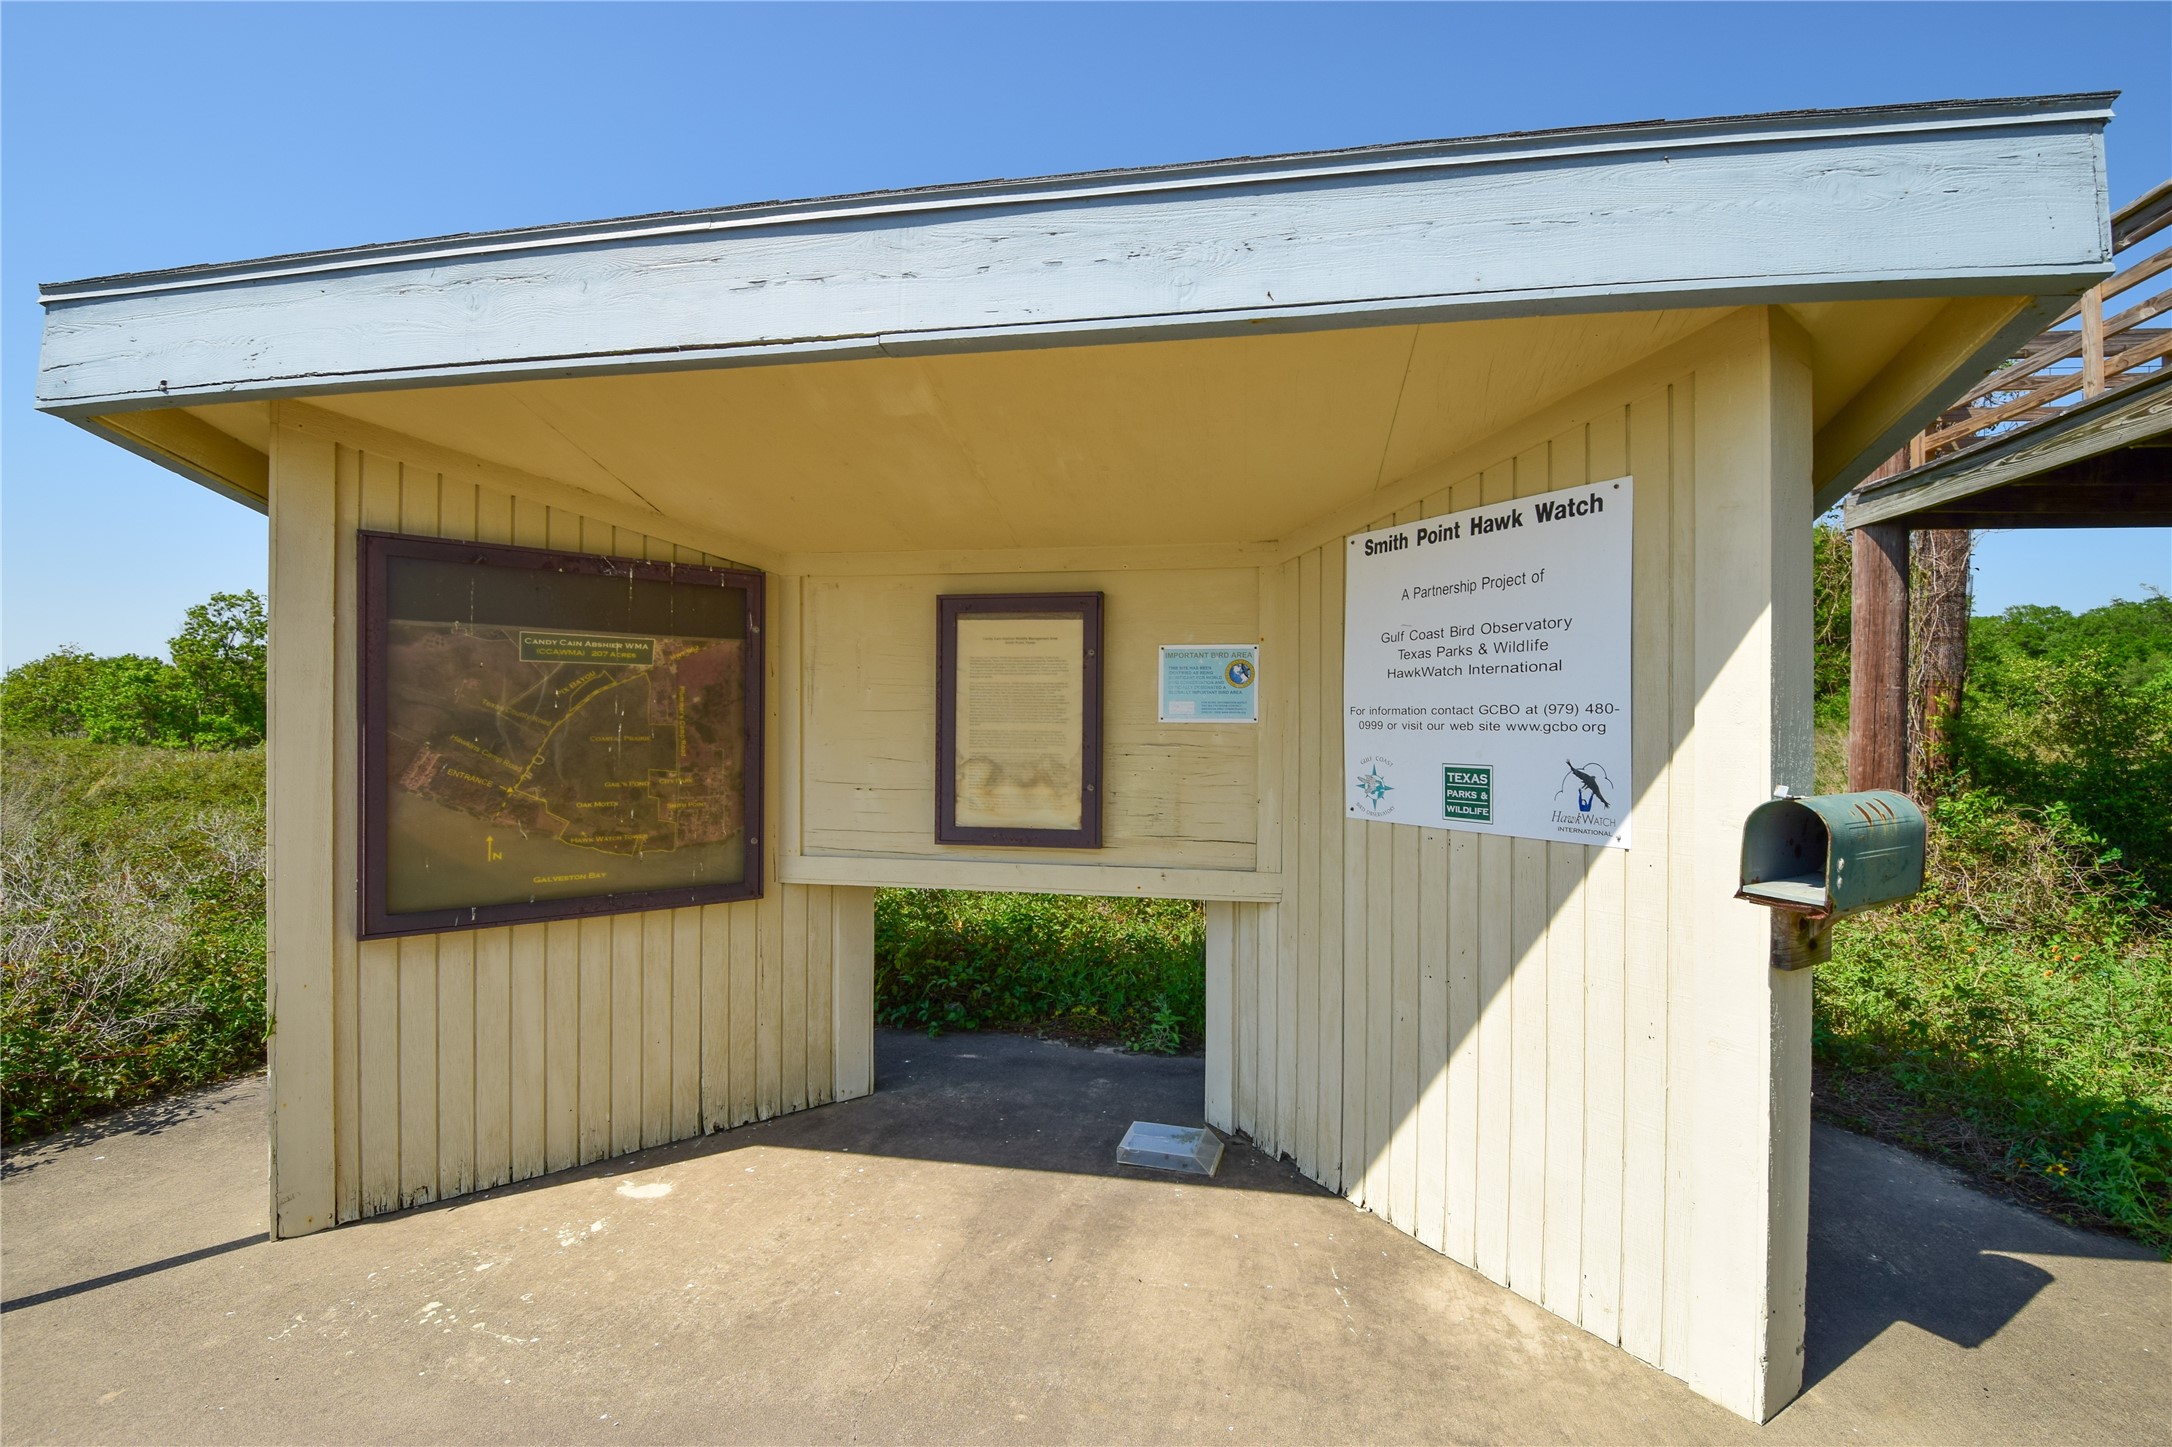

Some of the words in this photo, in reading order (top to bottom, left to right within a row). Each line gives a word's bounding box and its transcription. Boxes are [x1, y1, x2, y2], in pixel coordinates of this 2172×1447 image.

[1364, 532, 1409, 557] Smith
[1416, 521, 1461, 547] Point
[1470, 508, 1524, 537] Hawk
[1535, 492, 1604, 524] Watch
[1401, 588, 1410, 601] A
[1413, 578, 1477, 600] Partnership
[1481, 572, 1527, 592] Project
[1531, 568, 1546, 584] of
[1380, 630, 1406, 644] Gulf
[1409, 627, 1445, 642] Coast
[1450, 623, 1475, 638] Bird
[1480, 617, 1573, 635] Observatory
[624, 642, 649, 650] WMA
[1397, 648, 1432, 660] Texas
[1436, 644, 1473, 658] Parks
[1478, 642, 1488, 655] &
[1493, 638, 1549, 654] Wildlife
[1231, 651, 1253, 659] AREA
[1387, 664, 1463, 679] HawkWatch
[1468, 658, 1562, 676] International
[1350, 706, 1366, 716] For
[1369, 705, 1427, 716] information
[1431, 704, 1475, 716] contact
[1478, 703, 1520, 716] GCBO
[1525, 704, 1539, 715] at
[1543, 702, 1579, 717] (979)
[1584, 702, 1620, 715] 480-
[1358, 720, 1384, 731] 0999
[1386, 722, 1398, 731] or
[1401, 720, 1424, 731] visit
[1426, 722, 1446, 731] our
[1449, 720, 1475, 732] web
[1478, 720, 1502, 732] site
[447, 768, 494, 788] ENTRANCE
[1446, 772, 1488, 784] TEXAS
[1446, 789, 1478, 799] PARKS
[1480, 791, 1489, 800] &
[1446, 805, 1489, 816] WILDLIFE
[1557, 826, 1613, 837] INTERNATIONAL
[492, 852, 503, 860] N
